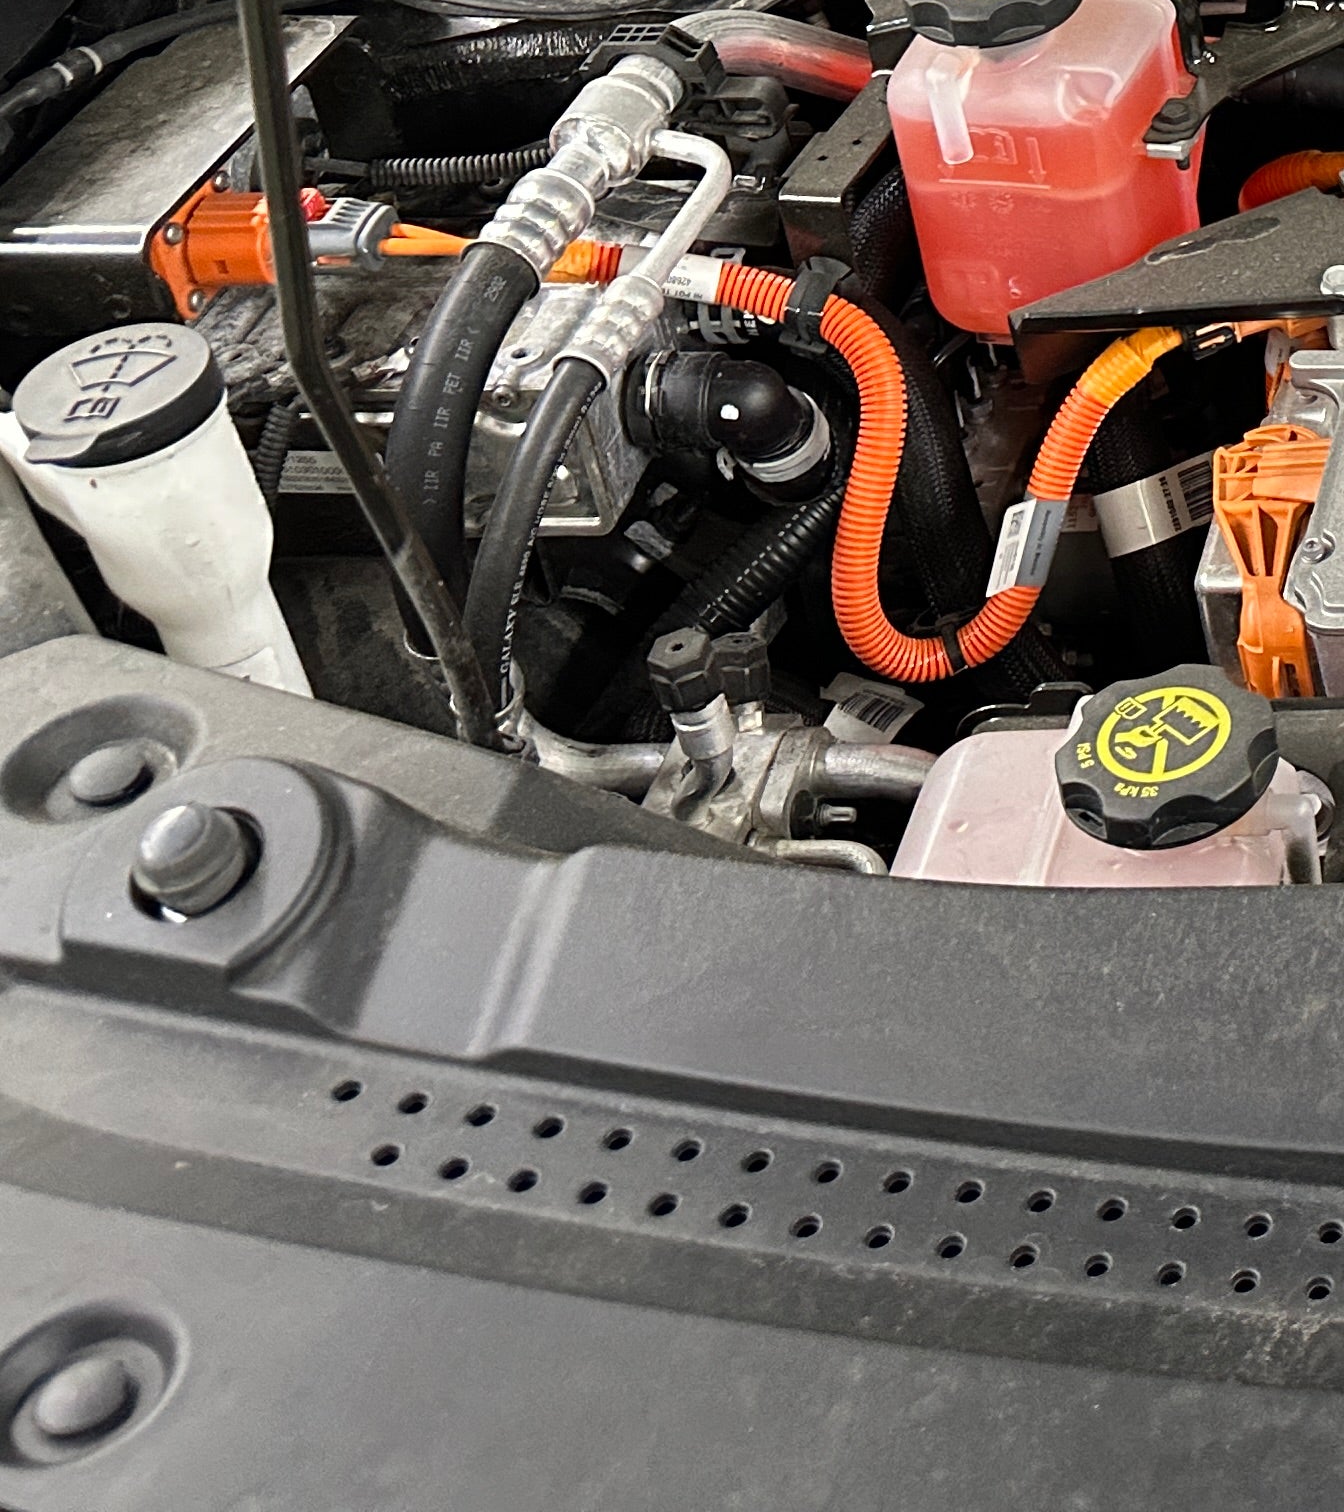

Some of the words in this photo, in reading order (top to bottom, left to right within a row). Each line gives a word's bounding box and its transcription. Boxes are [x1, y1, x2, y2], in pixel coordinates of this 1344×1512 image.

[1075, 742, 1092, 760] PSI
[1113, 782, 1139, 797] kPa
[1141, 785, 1159, 797] 35
